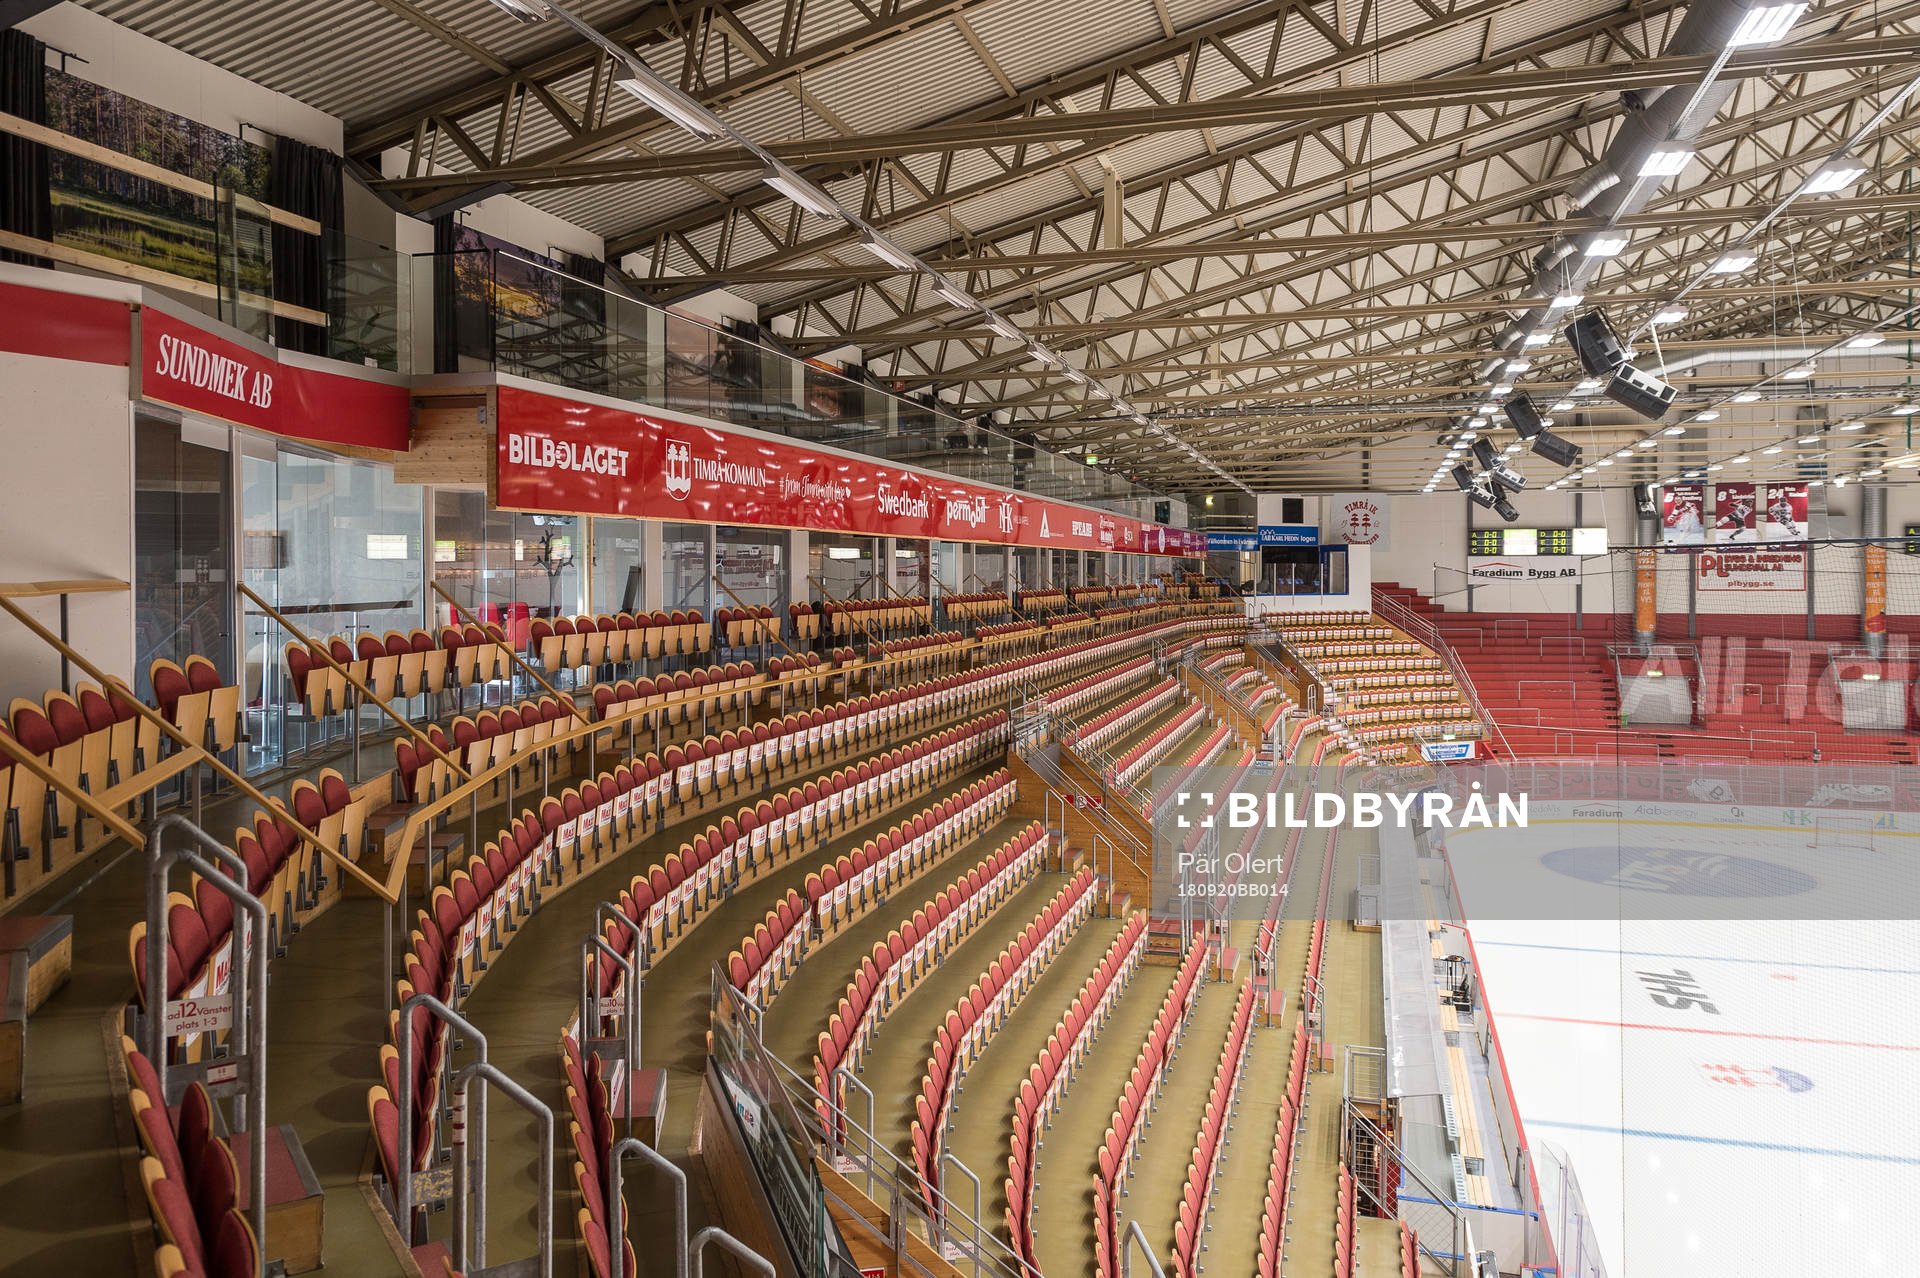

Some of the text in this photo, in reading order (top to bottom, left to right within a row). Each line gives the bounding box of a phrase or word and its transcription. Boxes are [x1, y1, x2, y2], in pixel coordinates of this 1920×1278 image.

[156, 334, 272, 409] SUNDMEK AB
[508, 433, 628, 476] BILBOLAGET
[724, 464, 766, 488] KOMMUN
[1718, 491, 1727, 501] 8
[1768, 489, 1784, 499] 24
[878, 487, 928, 519] Swedbank
[1344, 498, 1378, 514] TIMRÅ IK
[1472, 568, 1522, 577] Faradium
[1528, 568, 1556, 578] Bygg
[1701, 555, 1729, 577] PL
[1573, 809, 1623, 818] Faradium
[168, 1002, 232, 1020] ad 12 Vänster
[609, 999, 617, 1007] 10
[176, 1016, 218, 1032] plats 1-3
